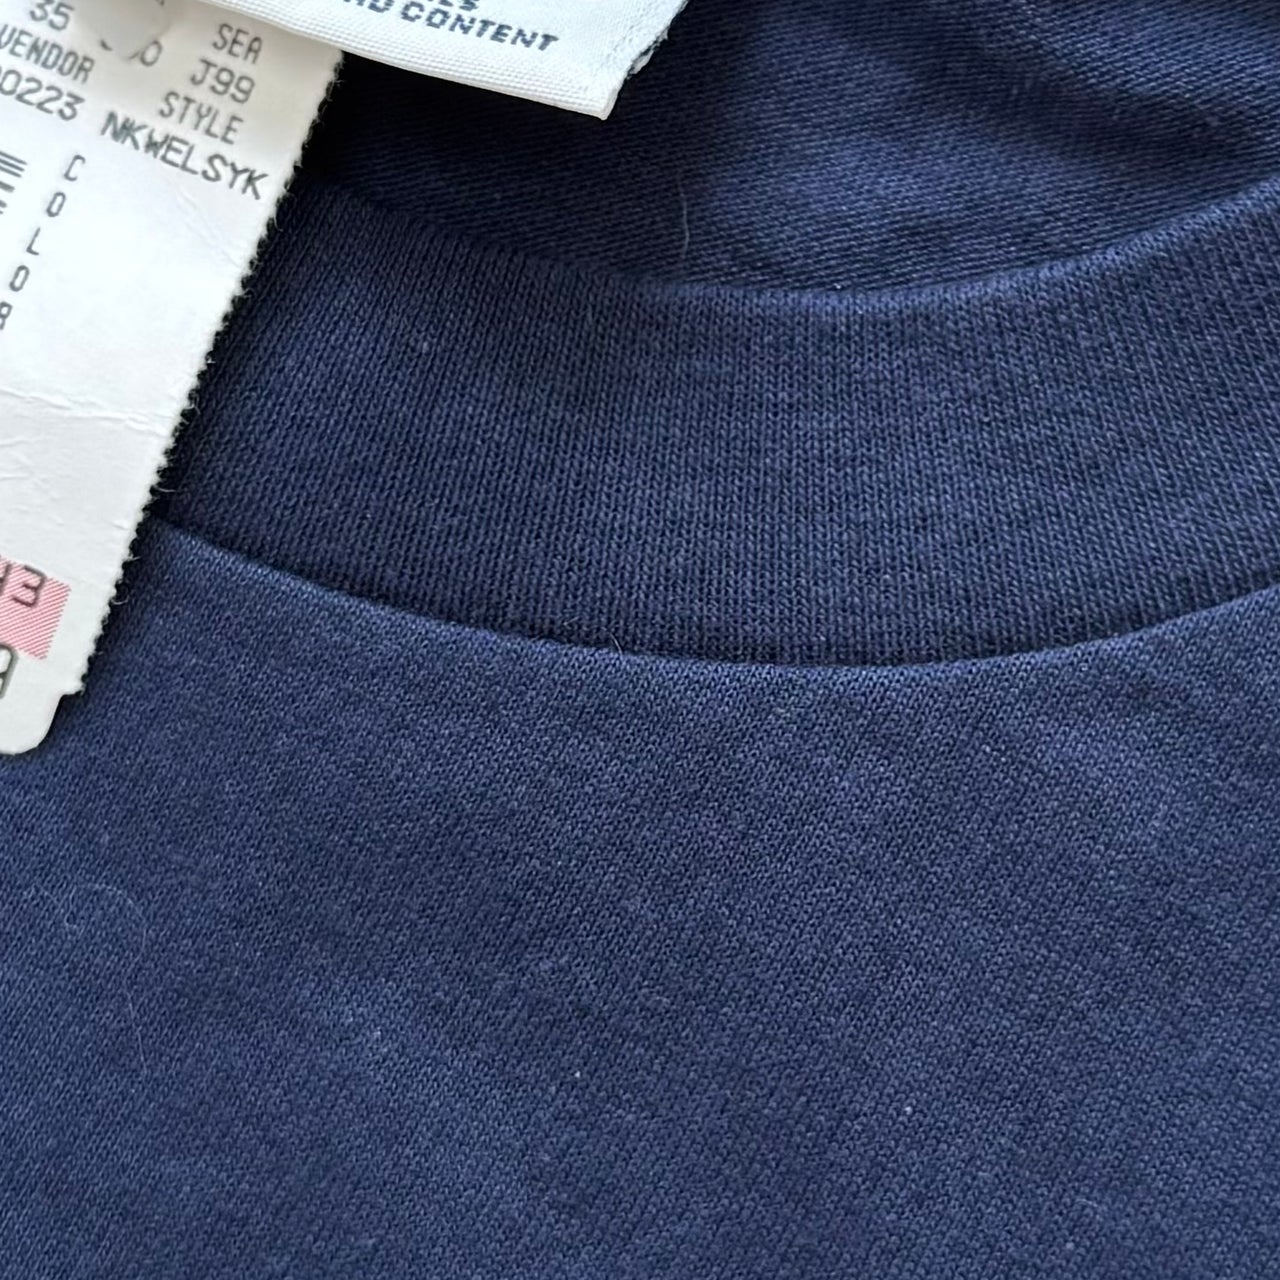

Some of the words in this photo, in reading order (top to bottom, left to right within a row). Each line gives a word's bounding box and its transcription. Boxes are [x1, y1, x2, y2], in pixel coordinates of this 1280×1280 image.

[211, 21, 263, 65] SEA
[399, 0, 559, 53] CONTENT
[189, 58, 257, 105] J99
[158, 90, 245, 146] STYLE
